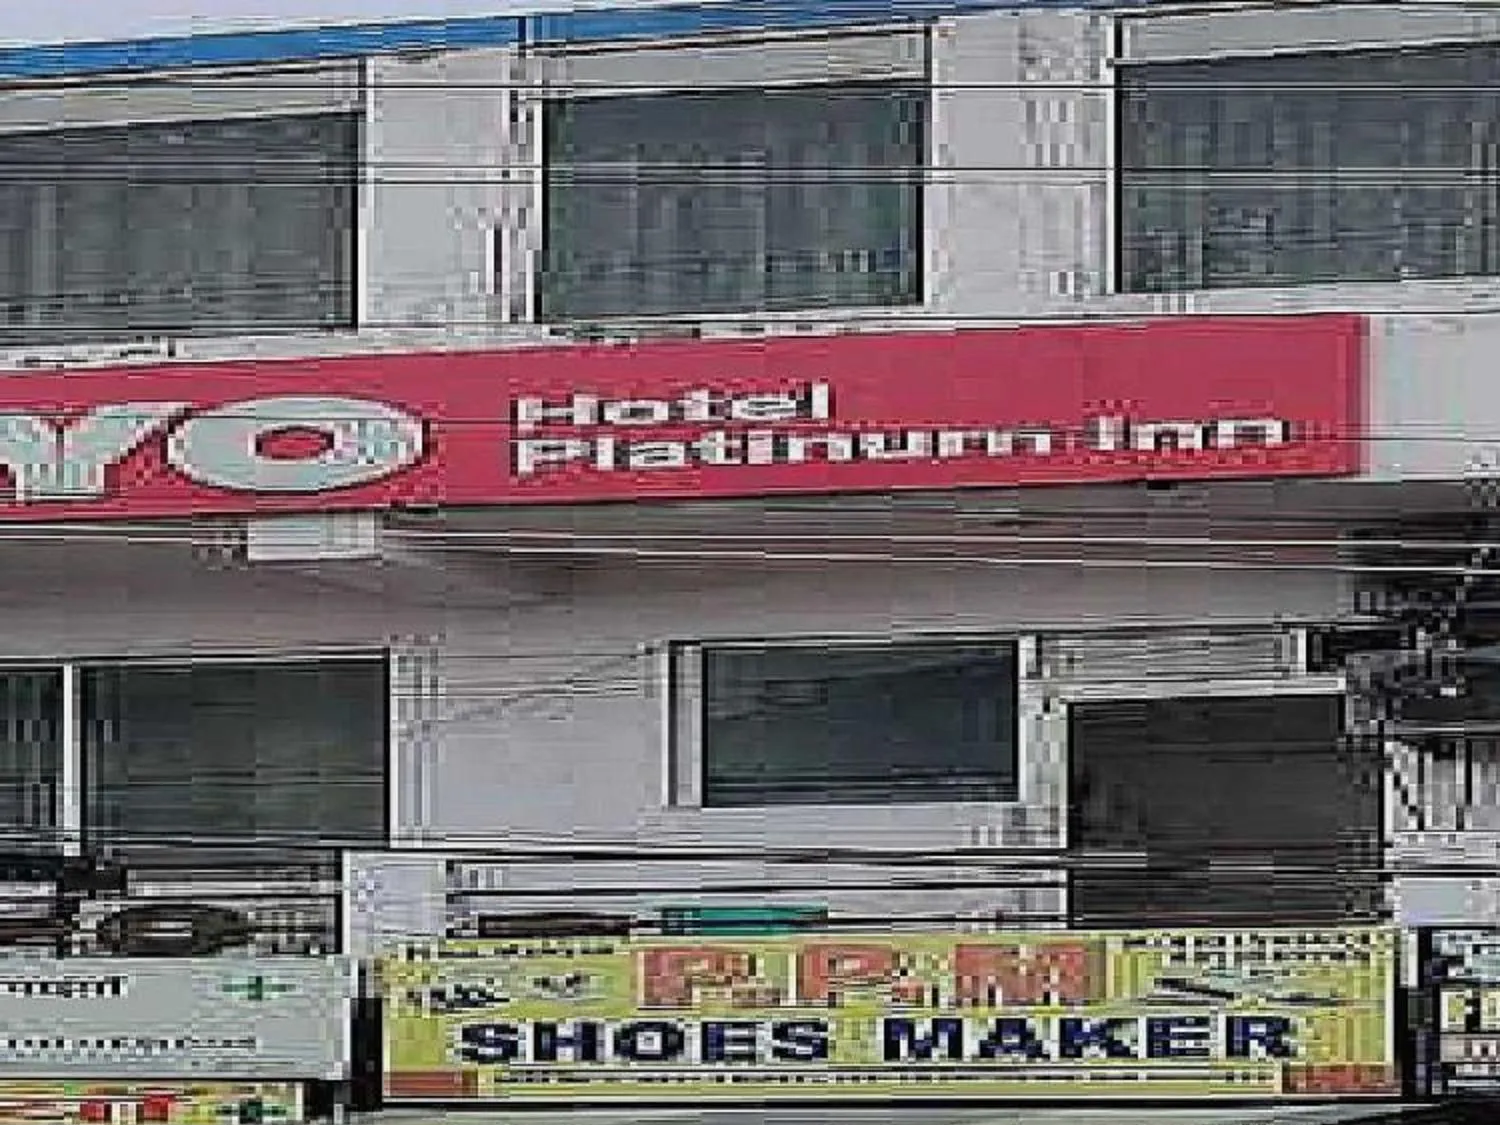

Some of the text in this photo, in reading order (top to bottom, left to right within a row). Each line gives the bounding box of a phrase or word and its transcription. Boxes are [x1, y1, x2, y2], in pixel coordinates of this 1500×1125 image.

[515, 383, 832, 428] Hotel
[515, 414, 1291, 476] Platinum Inn
[459, 1015, 1301, 1063] SHOES MAKER
